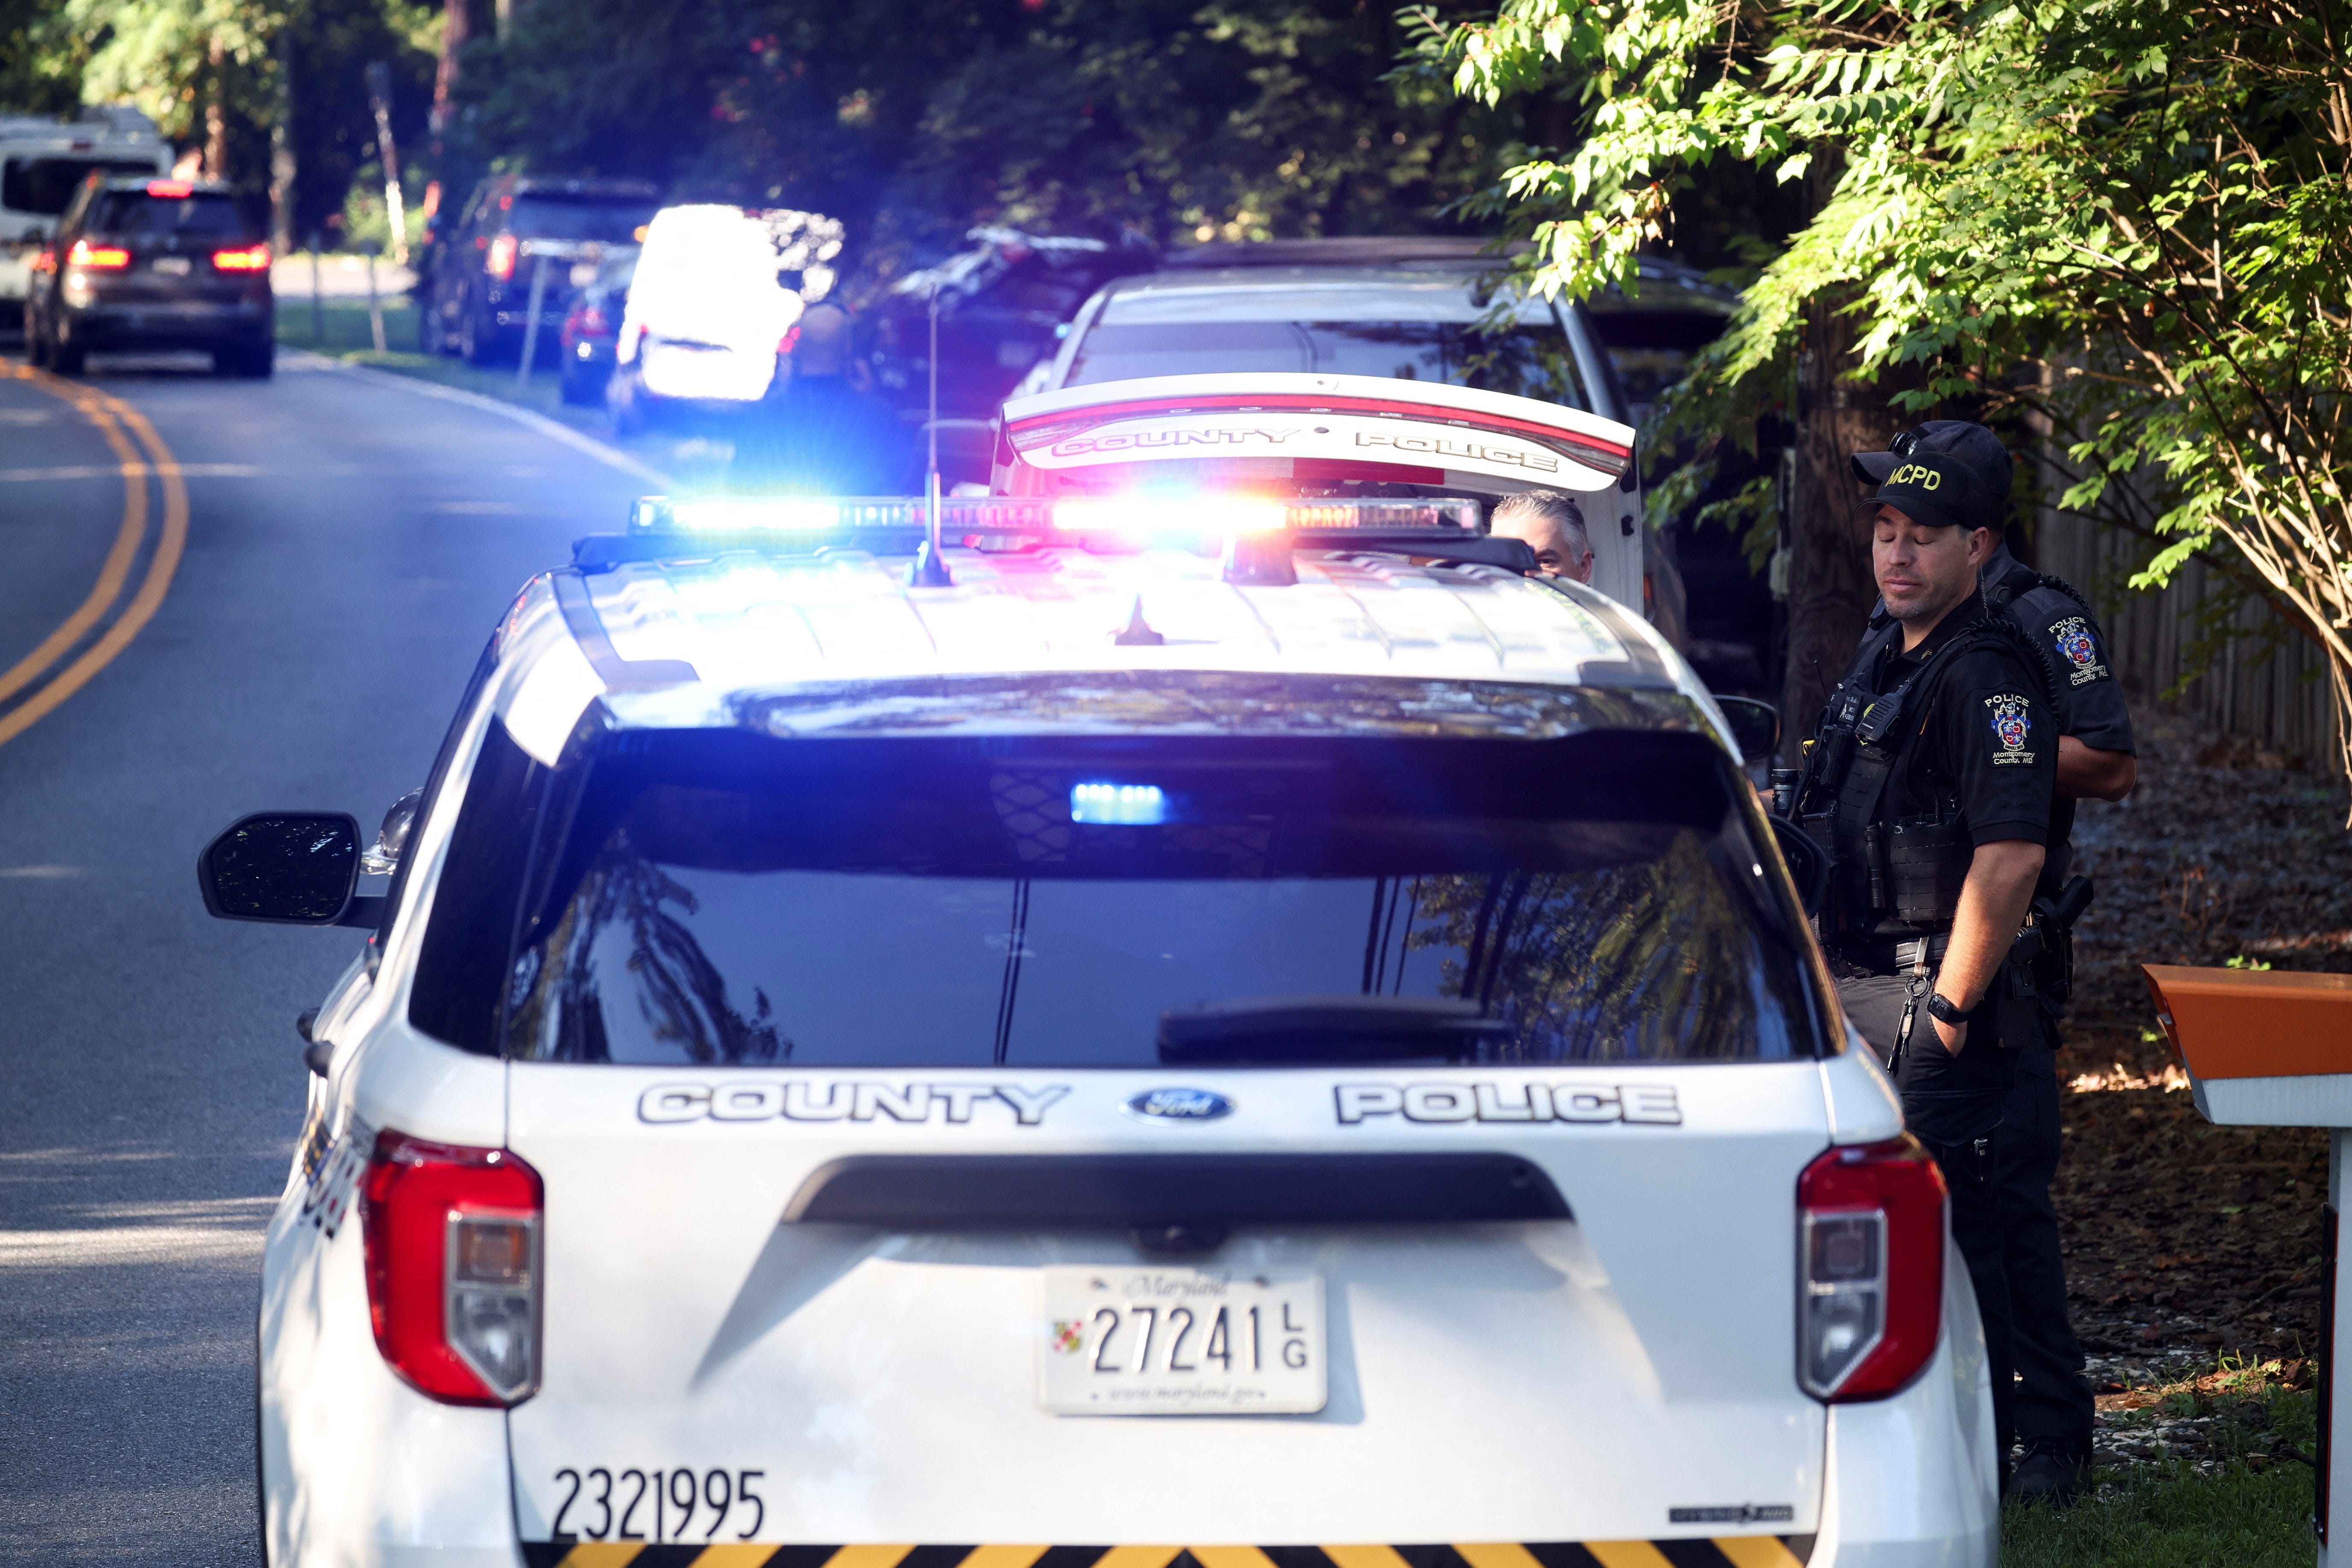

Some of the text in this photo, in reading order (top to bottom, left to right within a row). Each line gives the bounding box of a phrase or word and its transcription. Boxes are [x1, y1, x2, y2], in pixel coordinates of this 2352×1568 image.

[1052, 428, 1558, 472] COUNTY POLICE
[1884, 464, 1941, 490] MCPD
[2048, 617, 2086, 634] POLICE
[2070, 665, 2106, 680] Montgomery
[1984, 694, 2029, 708] POLICE
[638, 1081, 1072, 1125] COUNTY
[1145, 1090, 1214, 1116] Ford
[1334, 1083, 1683, 1125] POLICE
[1087, 1305, 1260, 1372] 27241
[552, 1468, 765, 1541] 2321995
